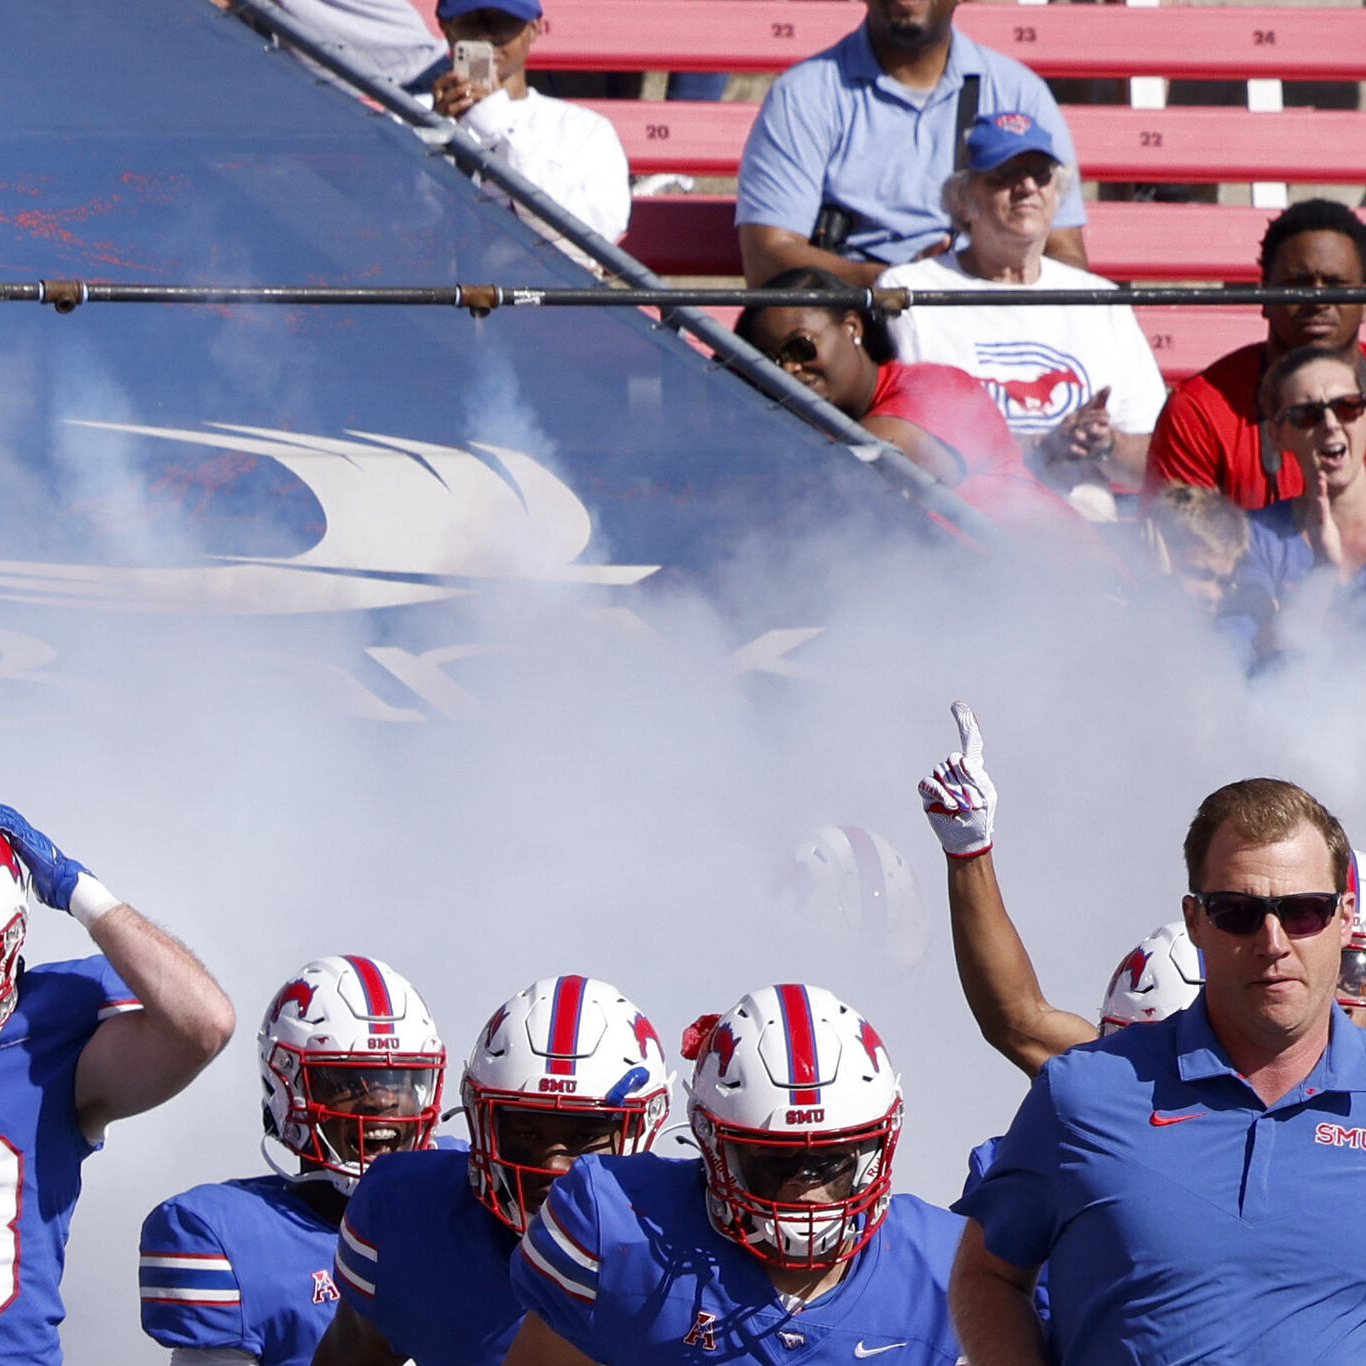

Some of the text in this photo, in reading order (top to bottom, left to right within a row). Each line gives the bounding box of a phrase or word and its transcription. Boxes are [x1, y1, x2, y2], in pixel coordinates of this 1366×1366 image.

[771, 22, 795, 38] 22
[1013, 26, 1037, 43] 23
[645, 124, 670, 140] 20
[1140, 131, 1163, 148] 22
[367, 1036, 401, 1052] SMU
[538, 1078, 578, 1095] SMU
[785, 1108, 825, 1126] SMU
